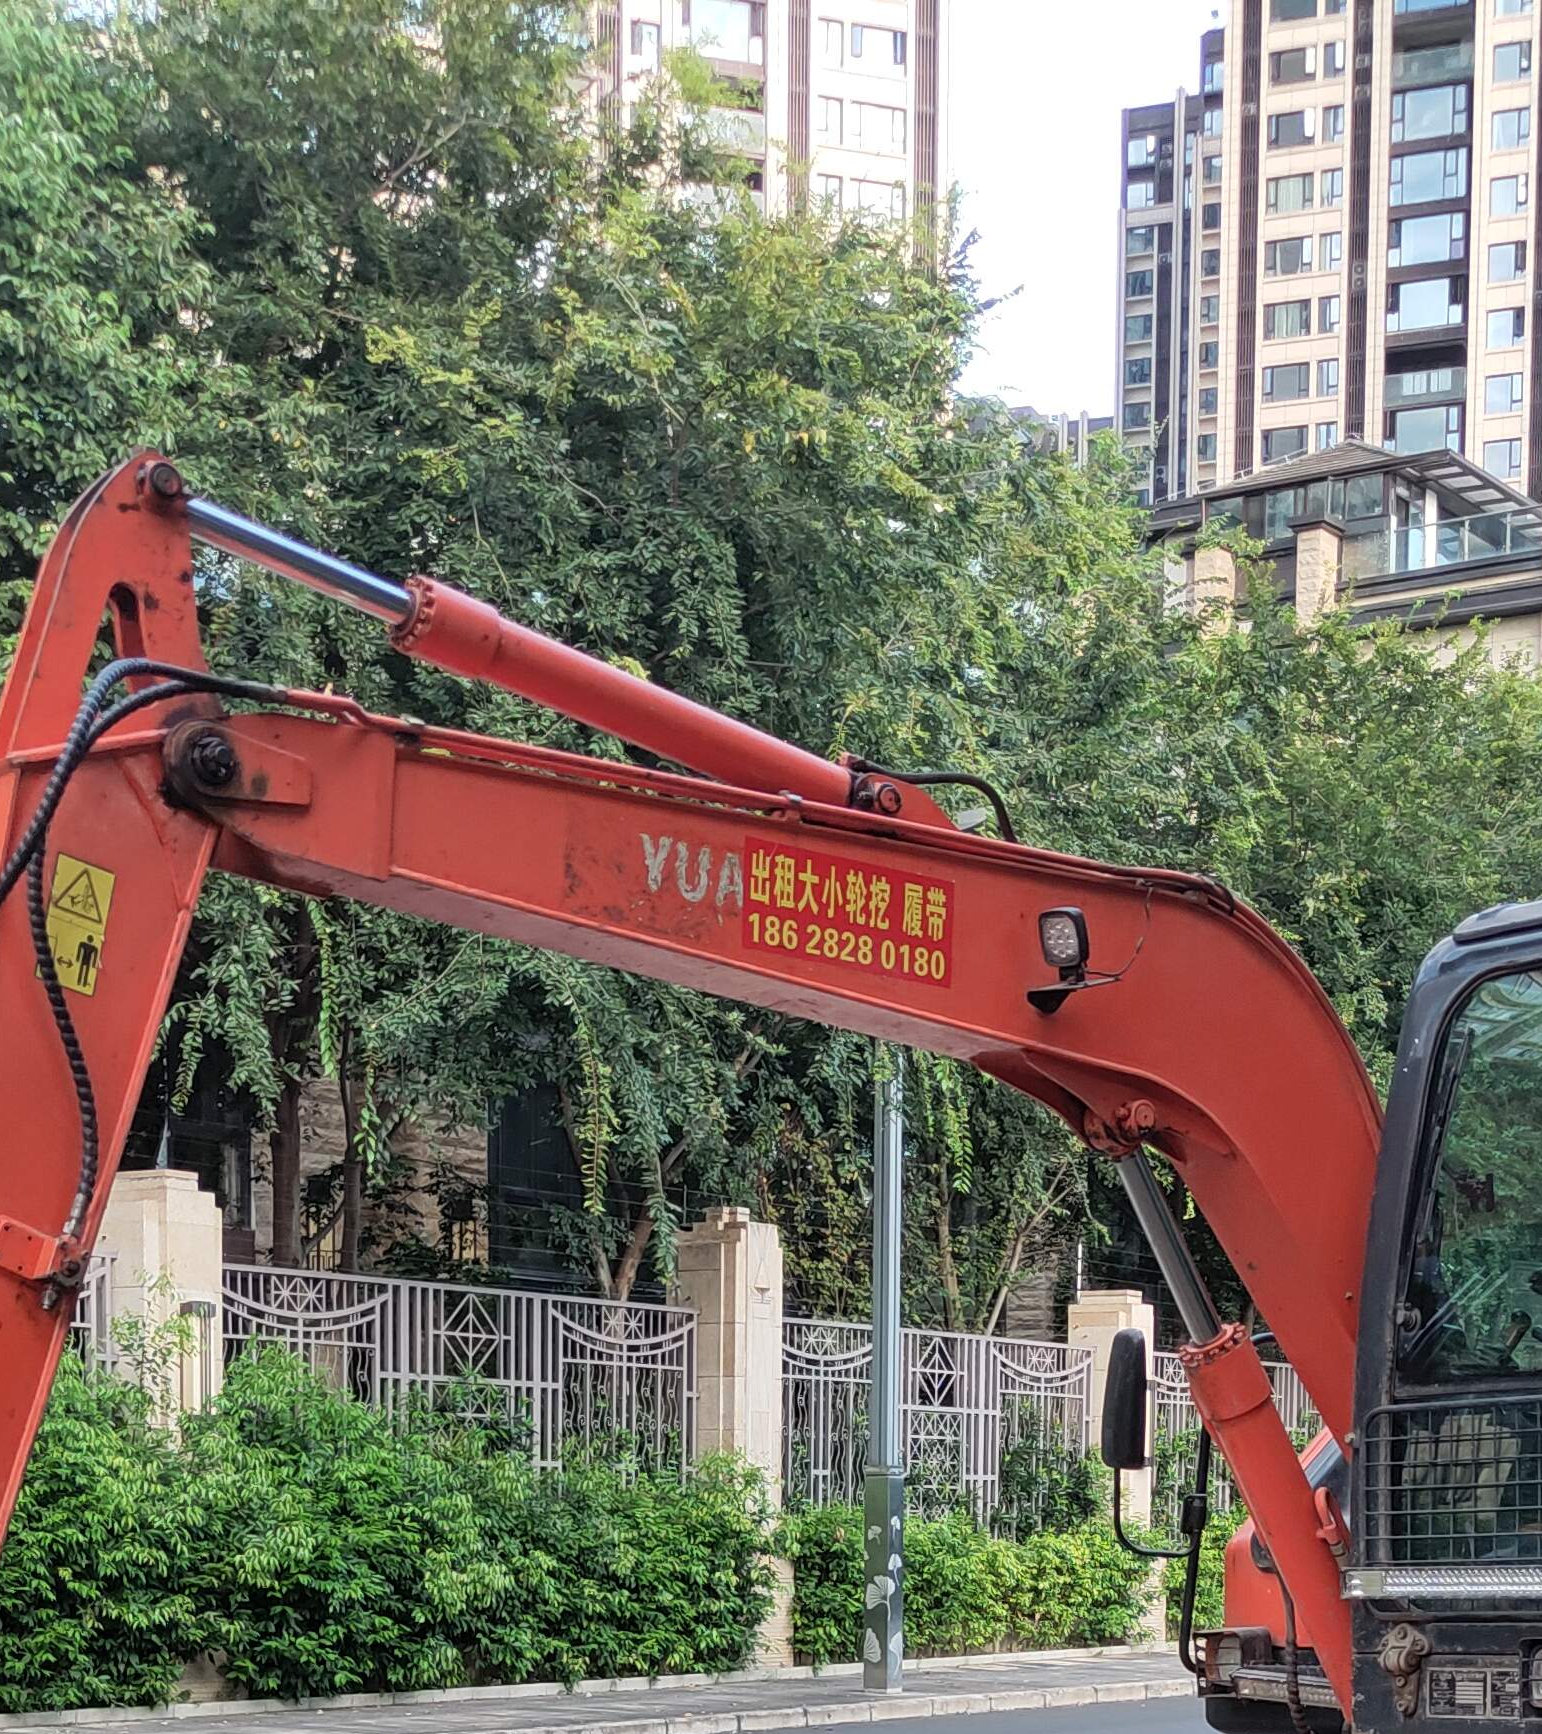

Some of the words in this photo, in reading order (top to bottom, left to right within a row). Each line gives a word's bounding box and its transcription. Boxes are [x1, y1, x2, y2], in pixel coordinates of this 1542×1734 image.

[750, 848, 891, 931] 出租大小轮挖
[902, 881, 947, 942] 履带
[748, 912, 799, 950] 186
[805, 924, 873, 966] 2828
[880, 939, 946, 981] 0180
